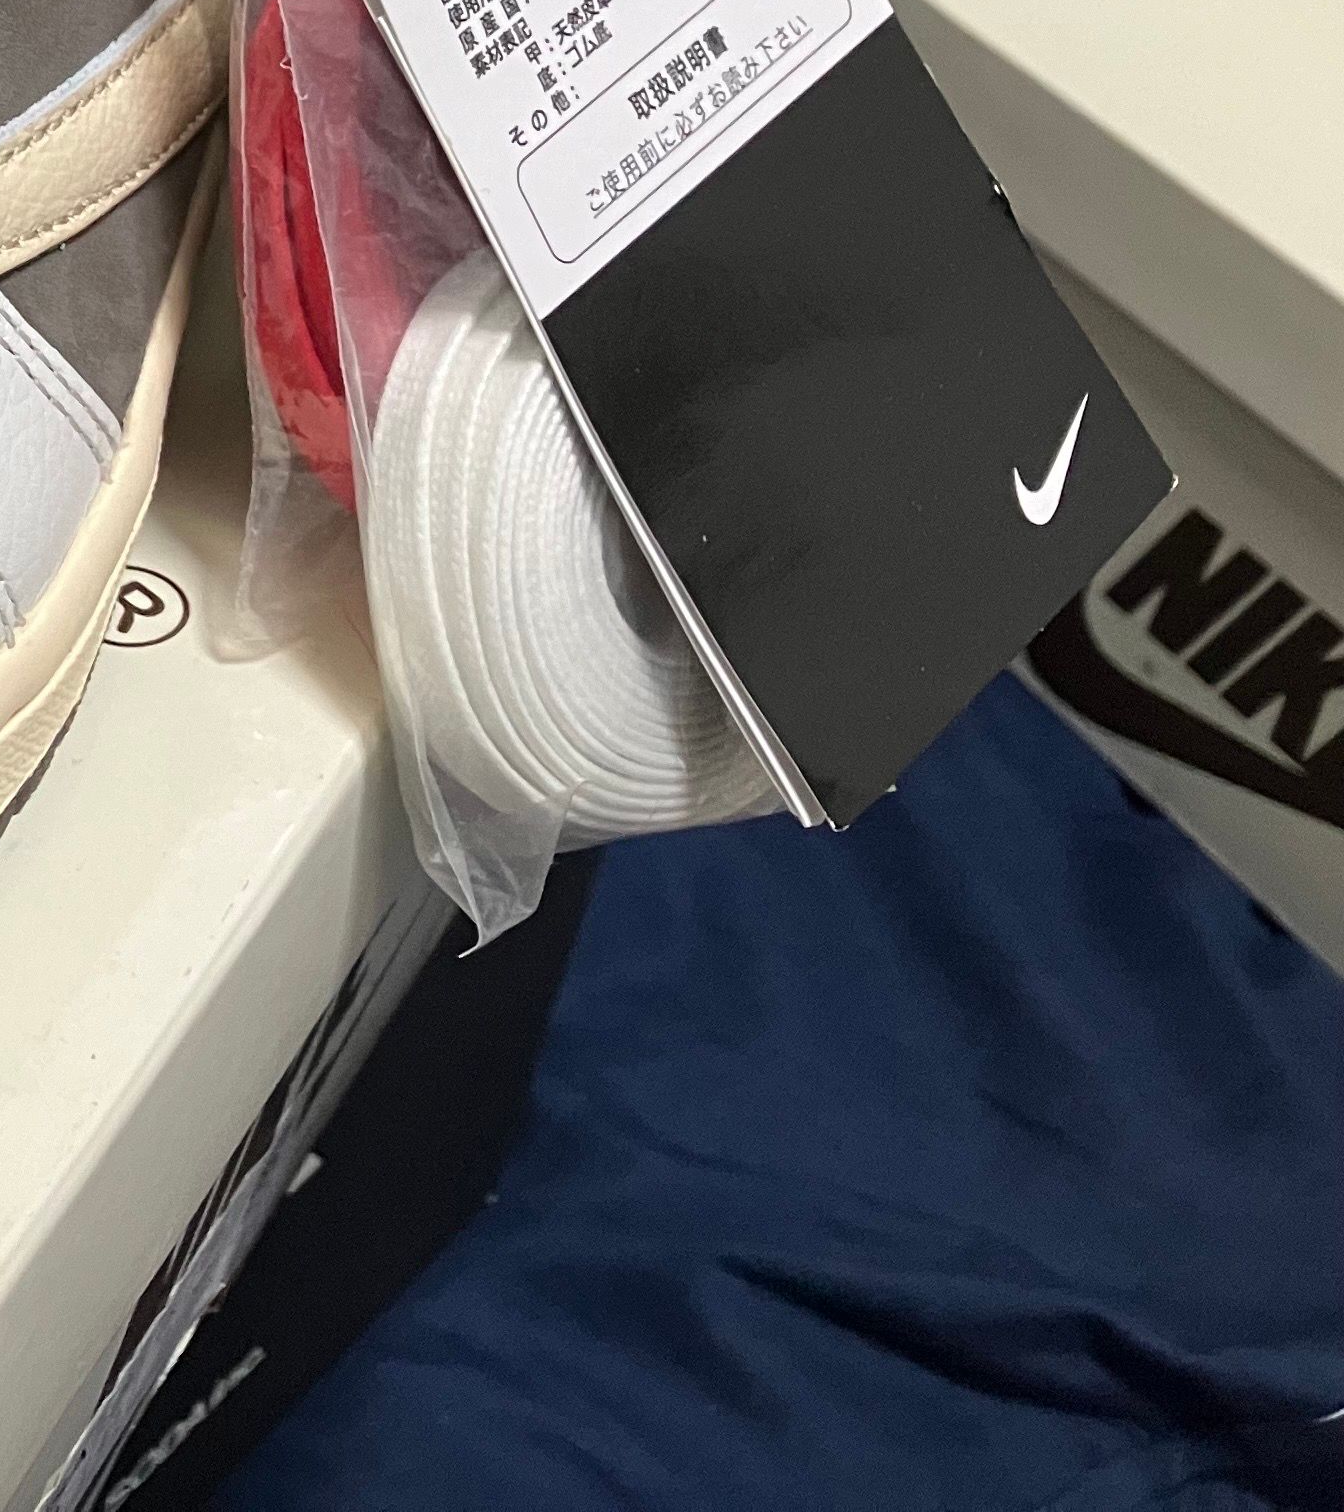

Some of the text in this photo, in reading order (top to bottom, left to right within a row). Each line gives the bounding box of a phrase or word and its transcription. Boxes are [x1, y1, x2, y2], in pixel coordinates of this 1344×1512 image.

[469, 16, 533, 79] 素材表記
[586, 14, 808, 214] ご使用前に必ずお読み下さい
[627, 26, 728, 120] 取扱説明書
[1107, 508, 1344, 780] NIK
